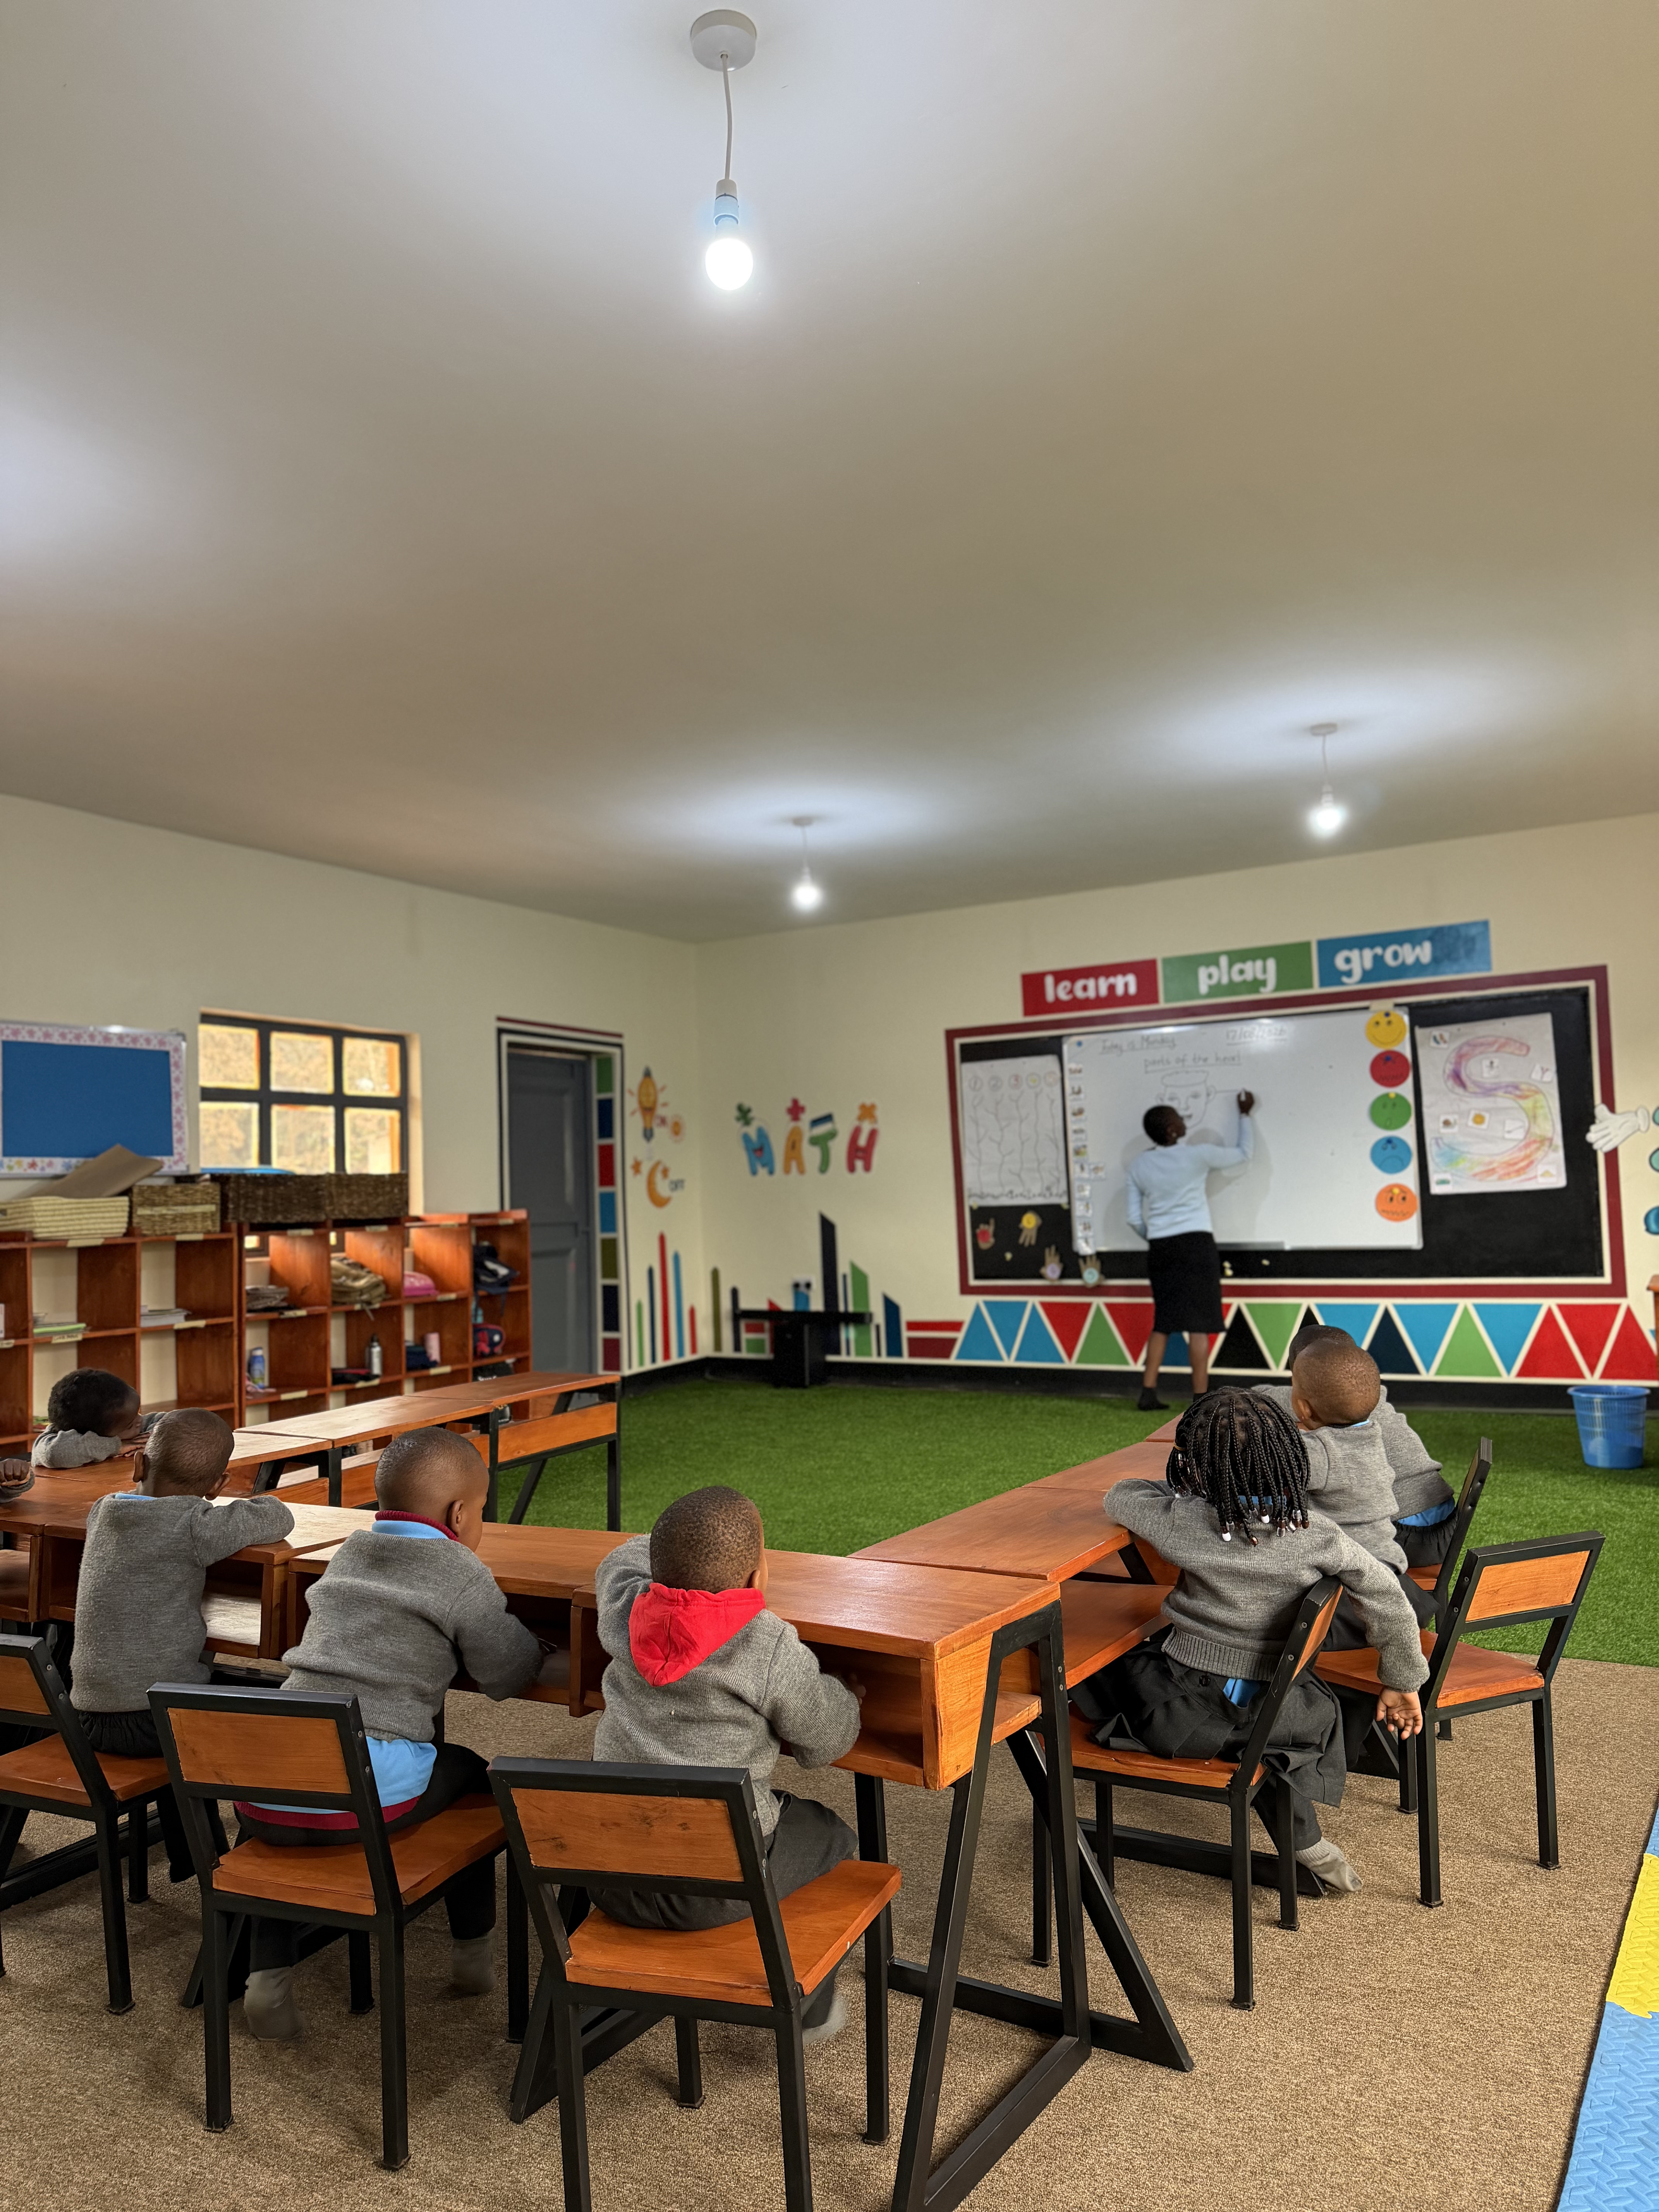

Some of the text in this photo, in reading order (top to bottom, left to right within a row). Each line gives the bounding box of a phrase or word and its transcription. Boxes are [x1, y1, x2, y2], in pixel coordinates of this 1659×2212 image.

[1198, 954, 1277, 995] play
[1334, 940, 1432, 985] grow
[1044, 973, 1137, 1003] learn
[1141, 1035, 1176, 1050] Monday
[1144, 1050, 1241, 1072] parts of the head
[742, 1125, 879, 1176] MATH
